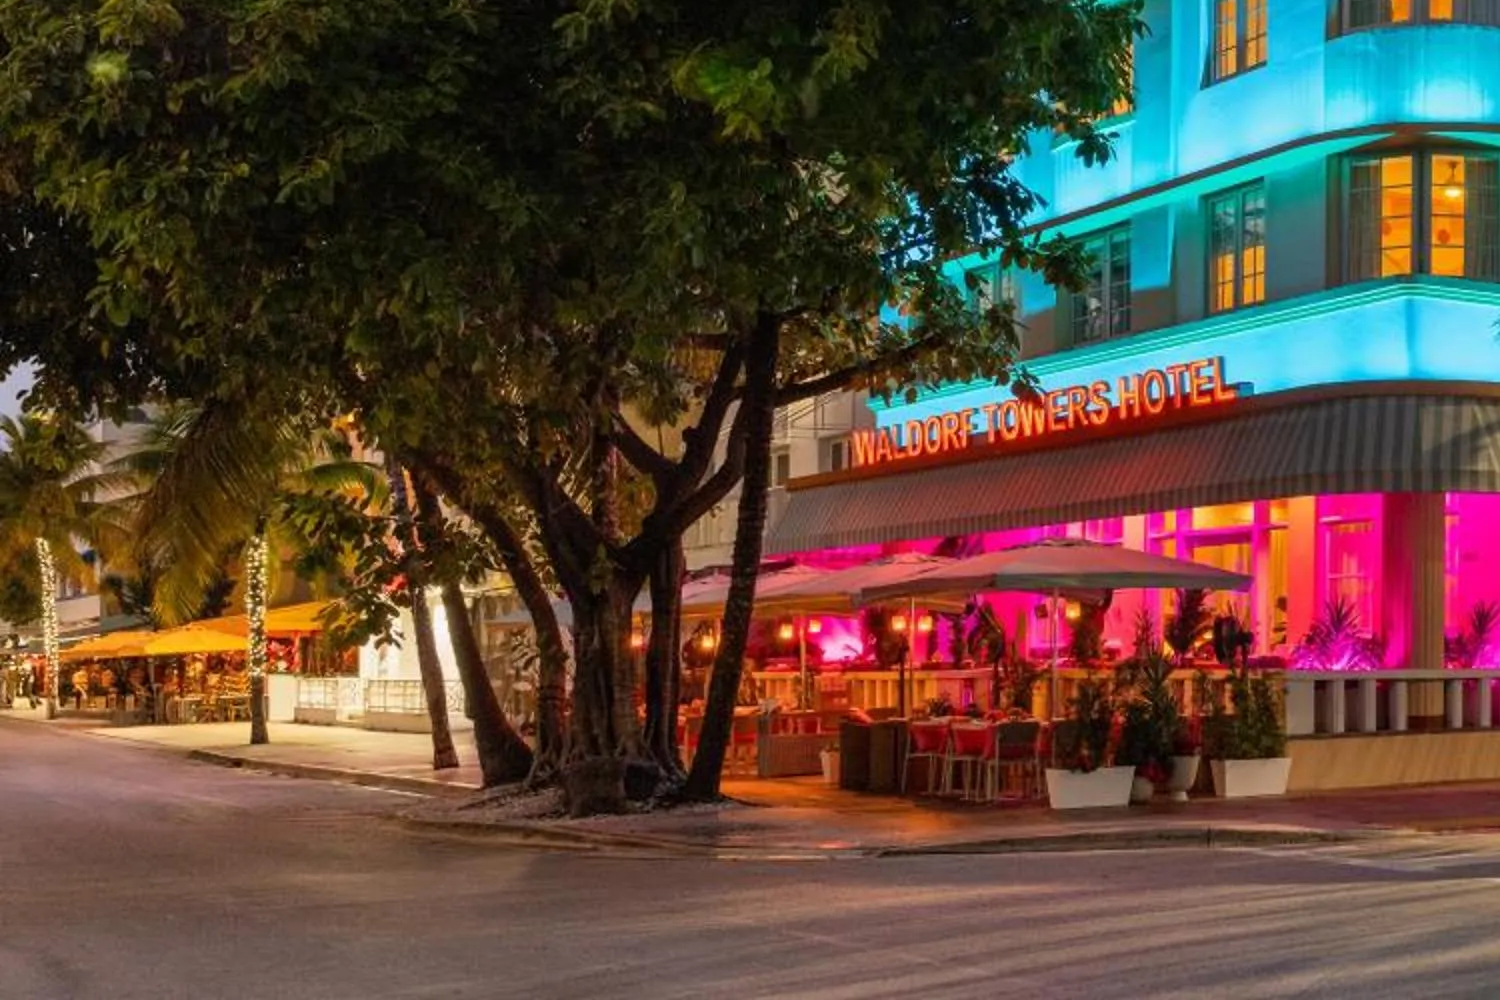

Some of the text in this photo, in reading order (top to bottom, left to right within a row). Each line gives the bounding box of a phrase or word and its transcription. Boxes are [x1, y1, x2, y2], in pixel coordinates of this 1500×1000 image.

[852, 355, 1237, 465] WALDORF TOWERS HOTEL
